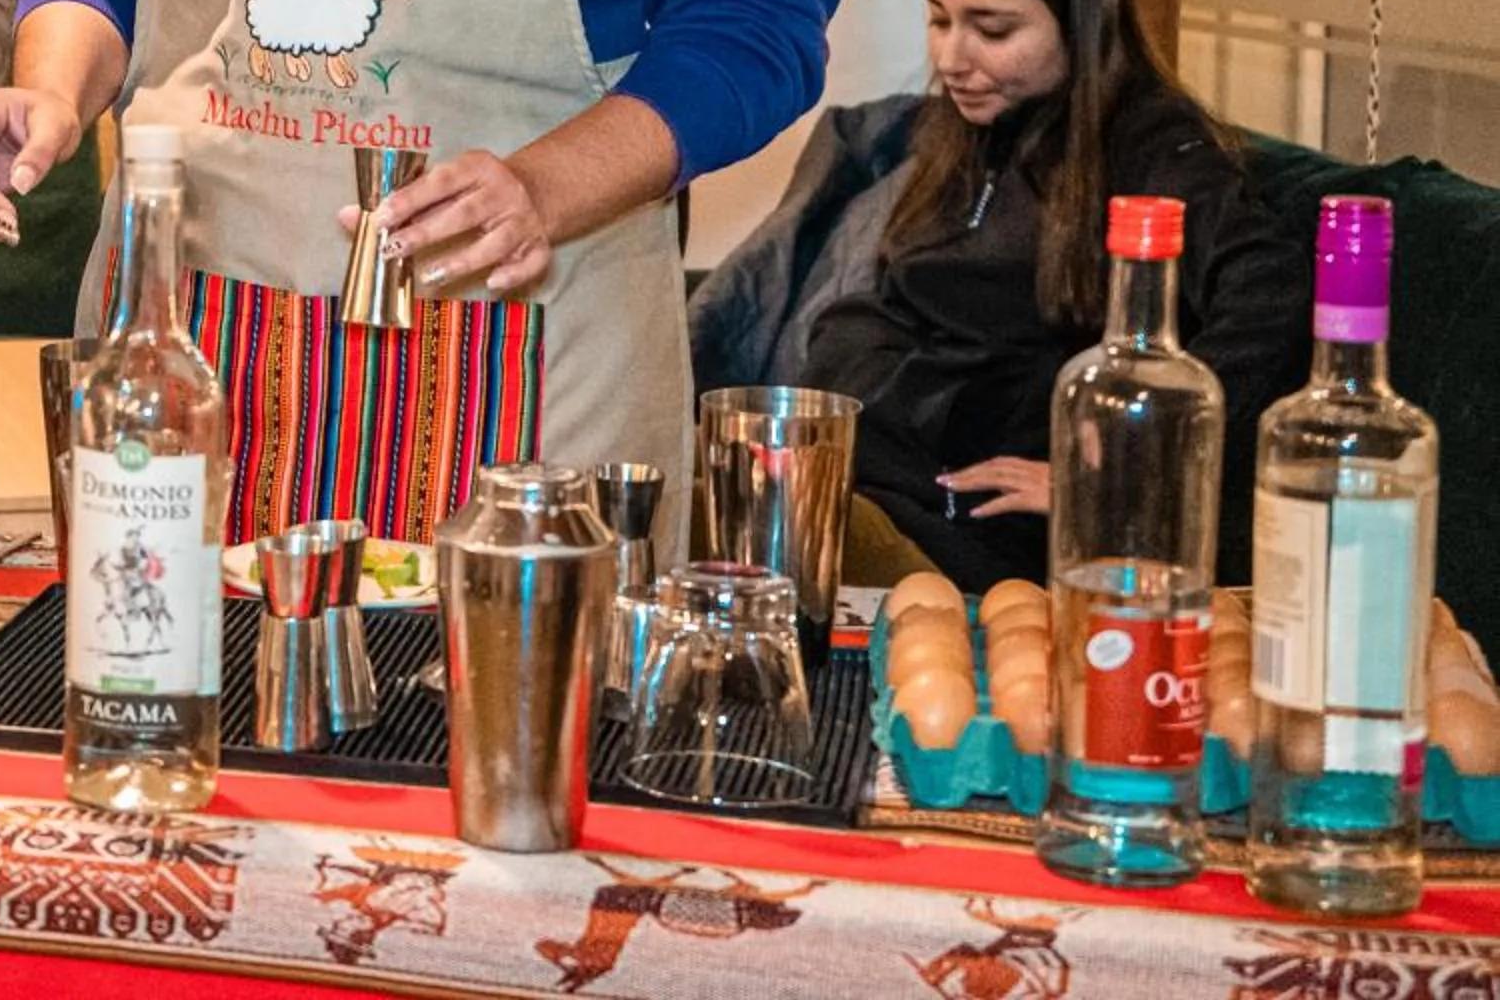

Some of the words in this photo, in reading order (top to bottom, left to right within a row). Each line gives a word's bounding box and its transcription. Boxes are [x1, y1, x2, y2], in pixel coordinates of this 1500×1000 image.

[201, 87, 303, 141] Machu
[312, 109, 432, 149] Picchu
[82, 471, 193, 501] DEMONIO
[116, 502, 192, 520] ANDES
[80, 694, 179, 723] TACAMA
